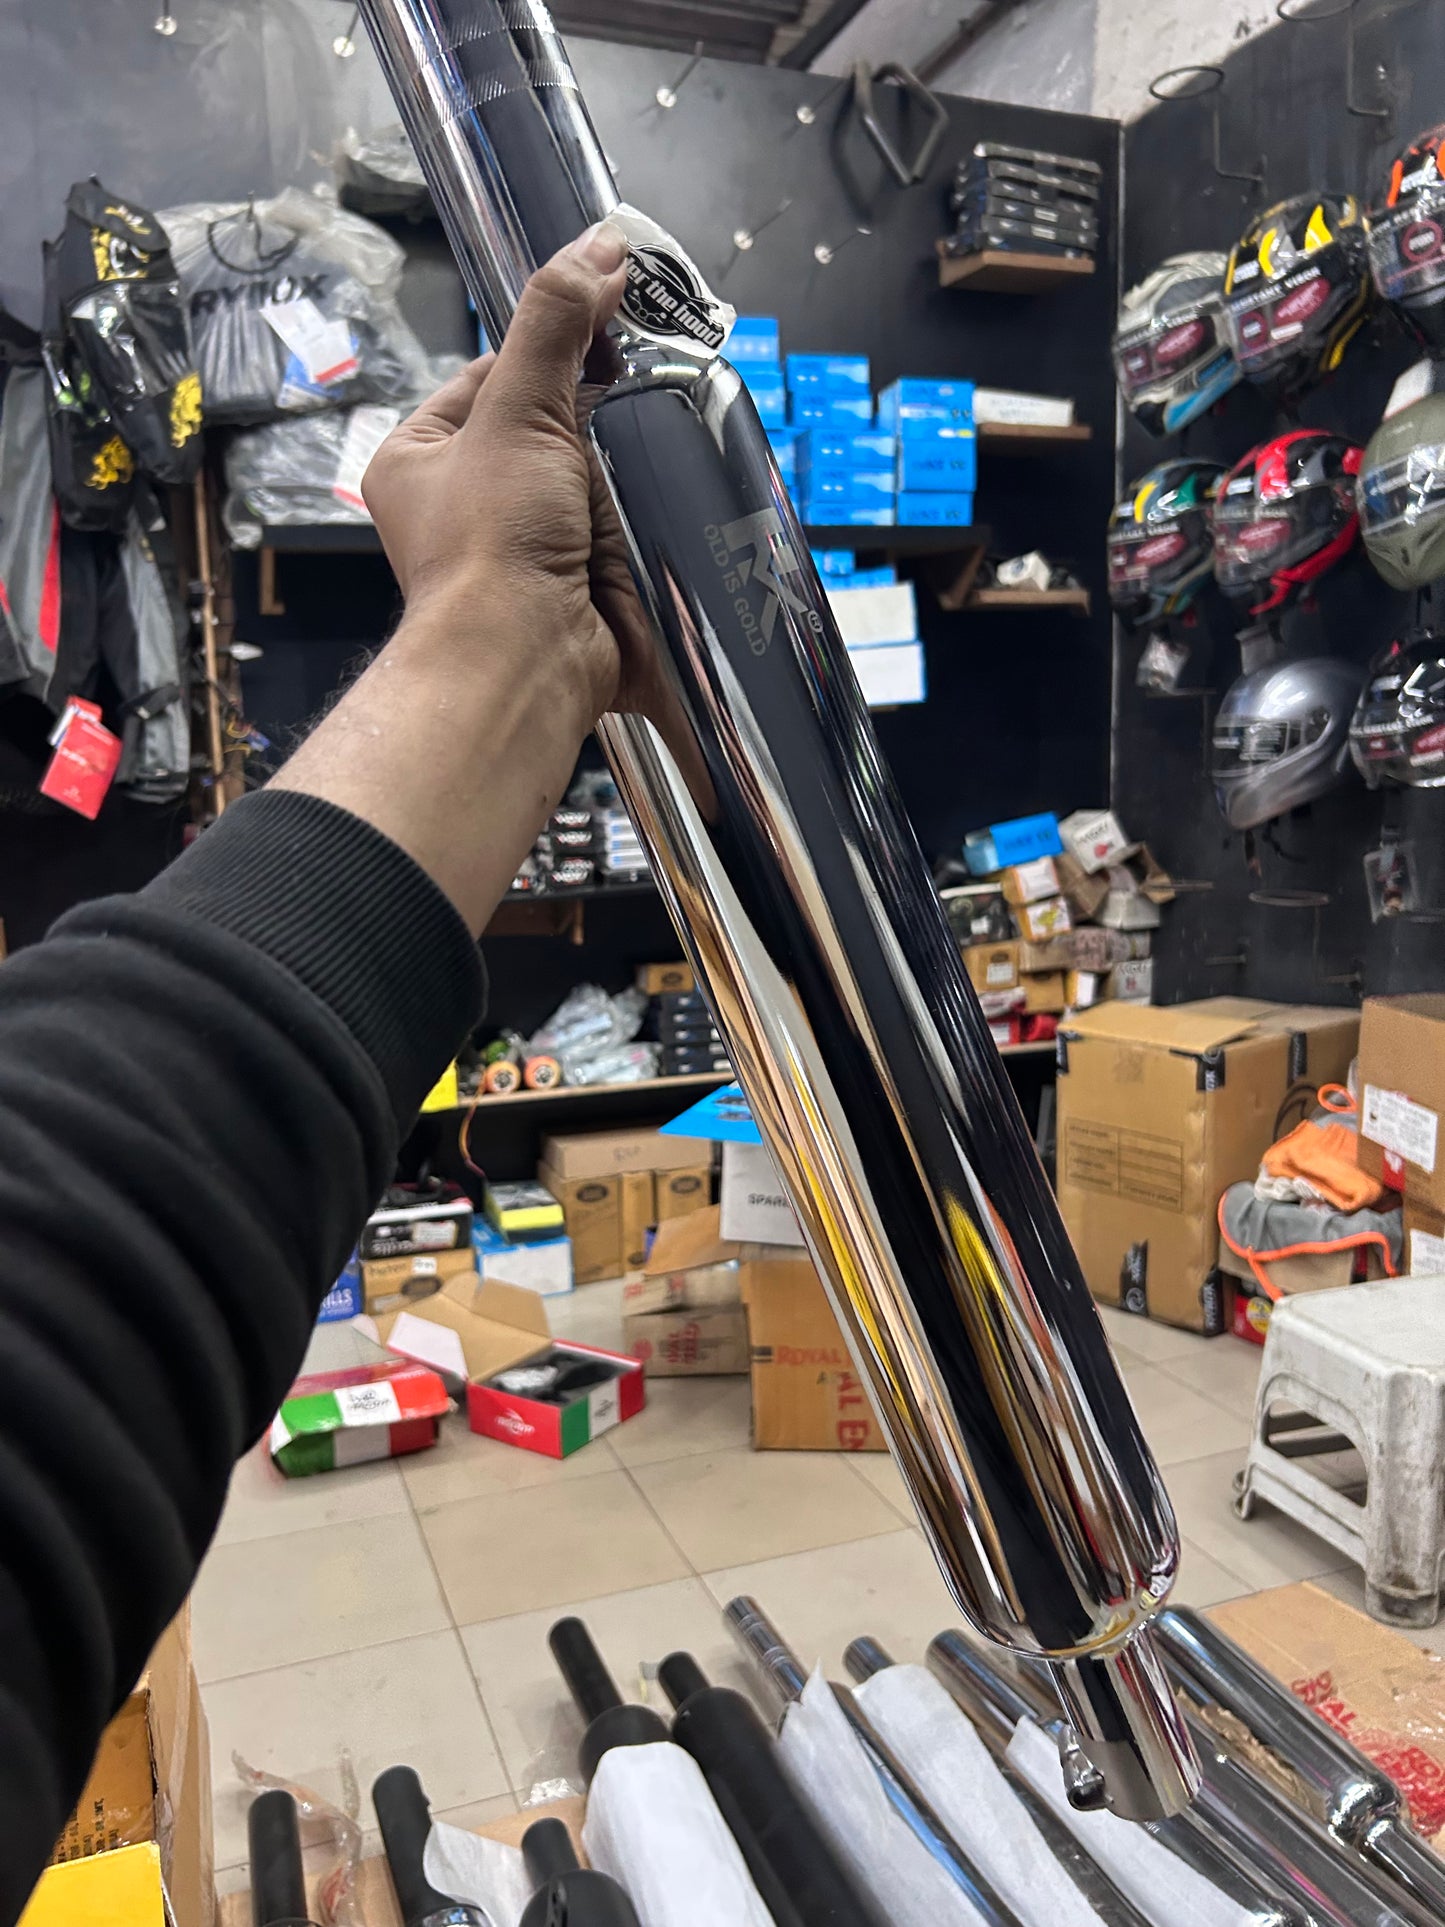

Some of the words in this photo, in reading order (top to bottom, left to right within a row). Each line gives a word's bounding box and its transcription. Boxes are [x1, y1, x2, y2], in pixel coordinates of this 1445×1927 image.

[644, 279, 679, 313] the
[672, 303, 723, 347] hood
[704, 523, 729, 567] OLD
[722, 571, 741, 593] IS
[734, 599, 767, 656] GOLD
